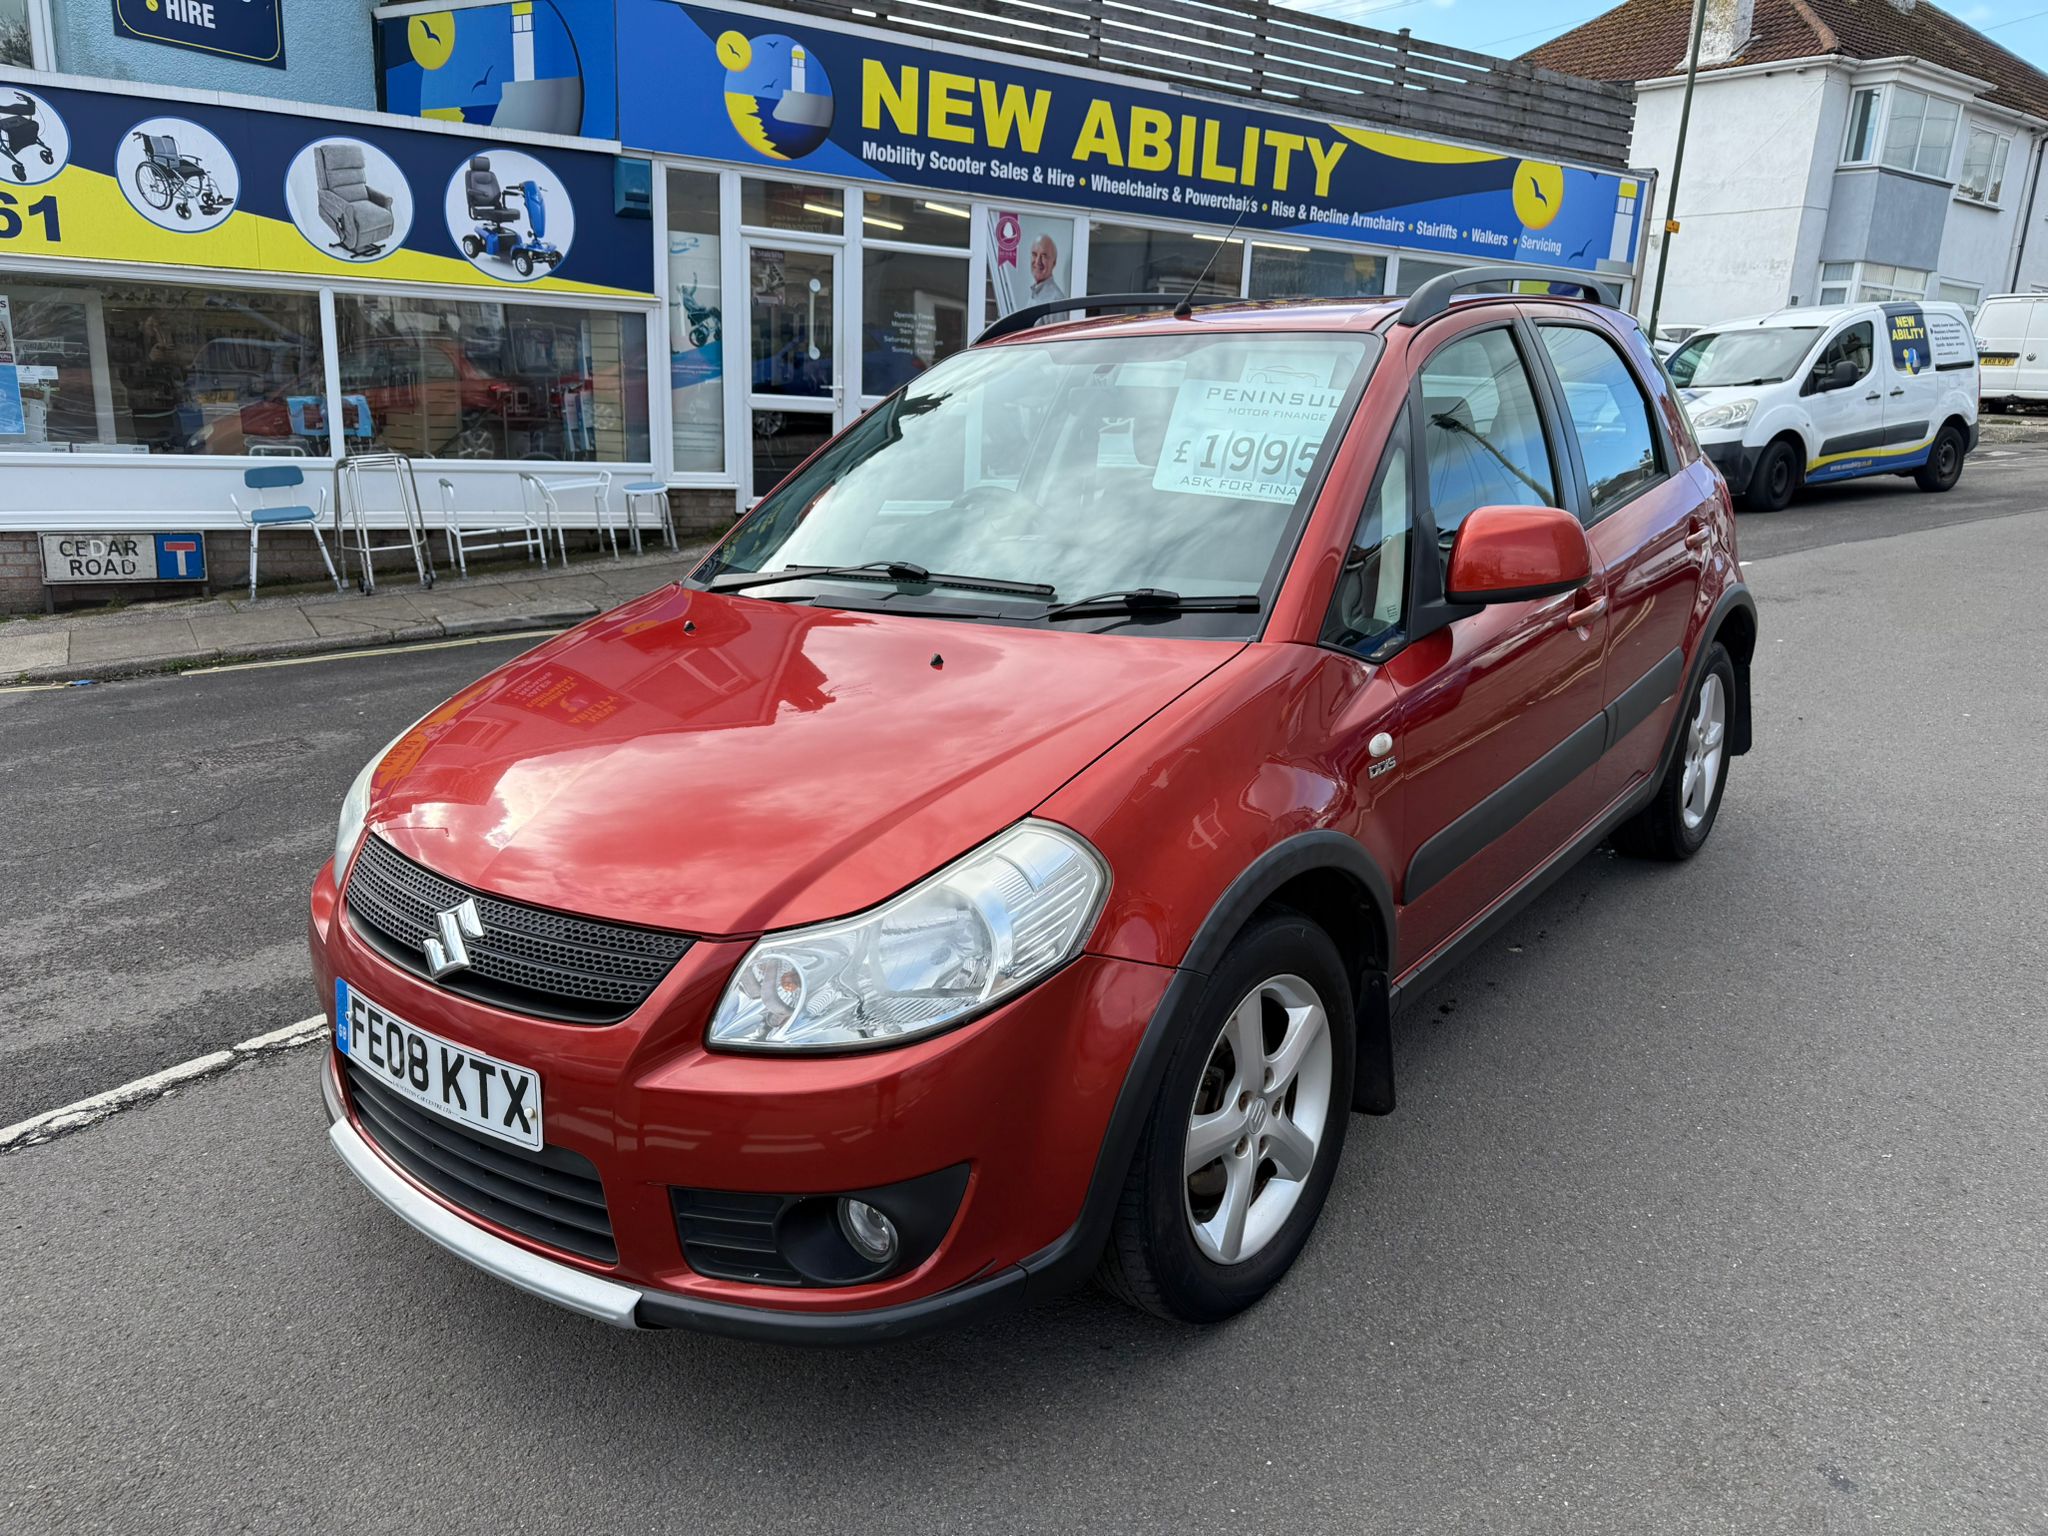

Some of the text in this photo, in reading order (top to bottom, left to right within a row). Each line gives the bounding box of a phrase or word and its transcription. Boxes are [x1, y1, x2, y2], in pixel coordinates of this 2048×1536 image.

[165, 0, 216, 30] HIRE
[861, 58, 1349, 198] NEW ABILITY
[862, 141, 1563, 256] Mobility Scooter Sales & Hire Wheelchairs & Powerchairs Rise & Recline Armchairs Stairlifts Walkers Servicing
[1895, 315, 1915, 328] NEW
[1891, 327, 1924, 341] ABILITY
[1228, 407, 1327, 422] MOTOR FINANCE
[1179, 475, 1214, 489] ASK
[1219, 480, 1253, 493] FOR
[59, 539, 139, 558] CEDAR
[69, 558, 137, 577] ROAD
[350, 995, 430, 1093] FE08
[440, 1046, 532, 1135] KTX
